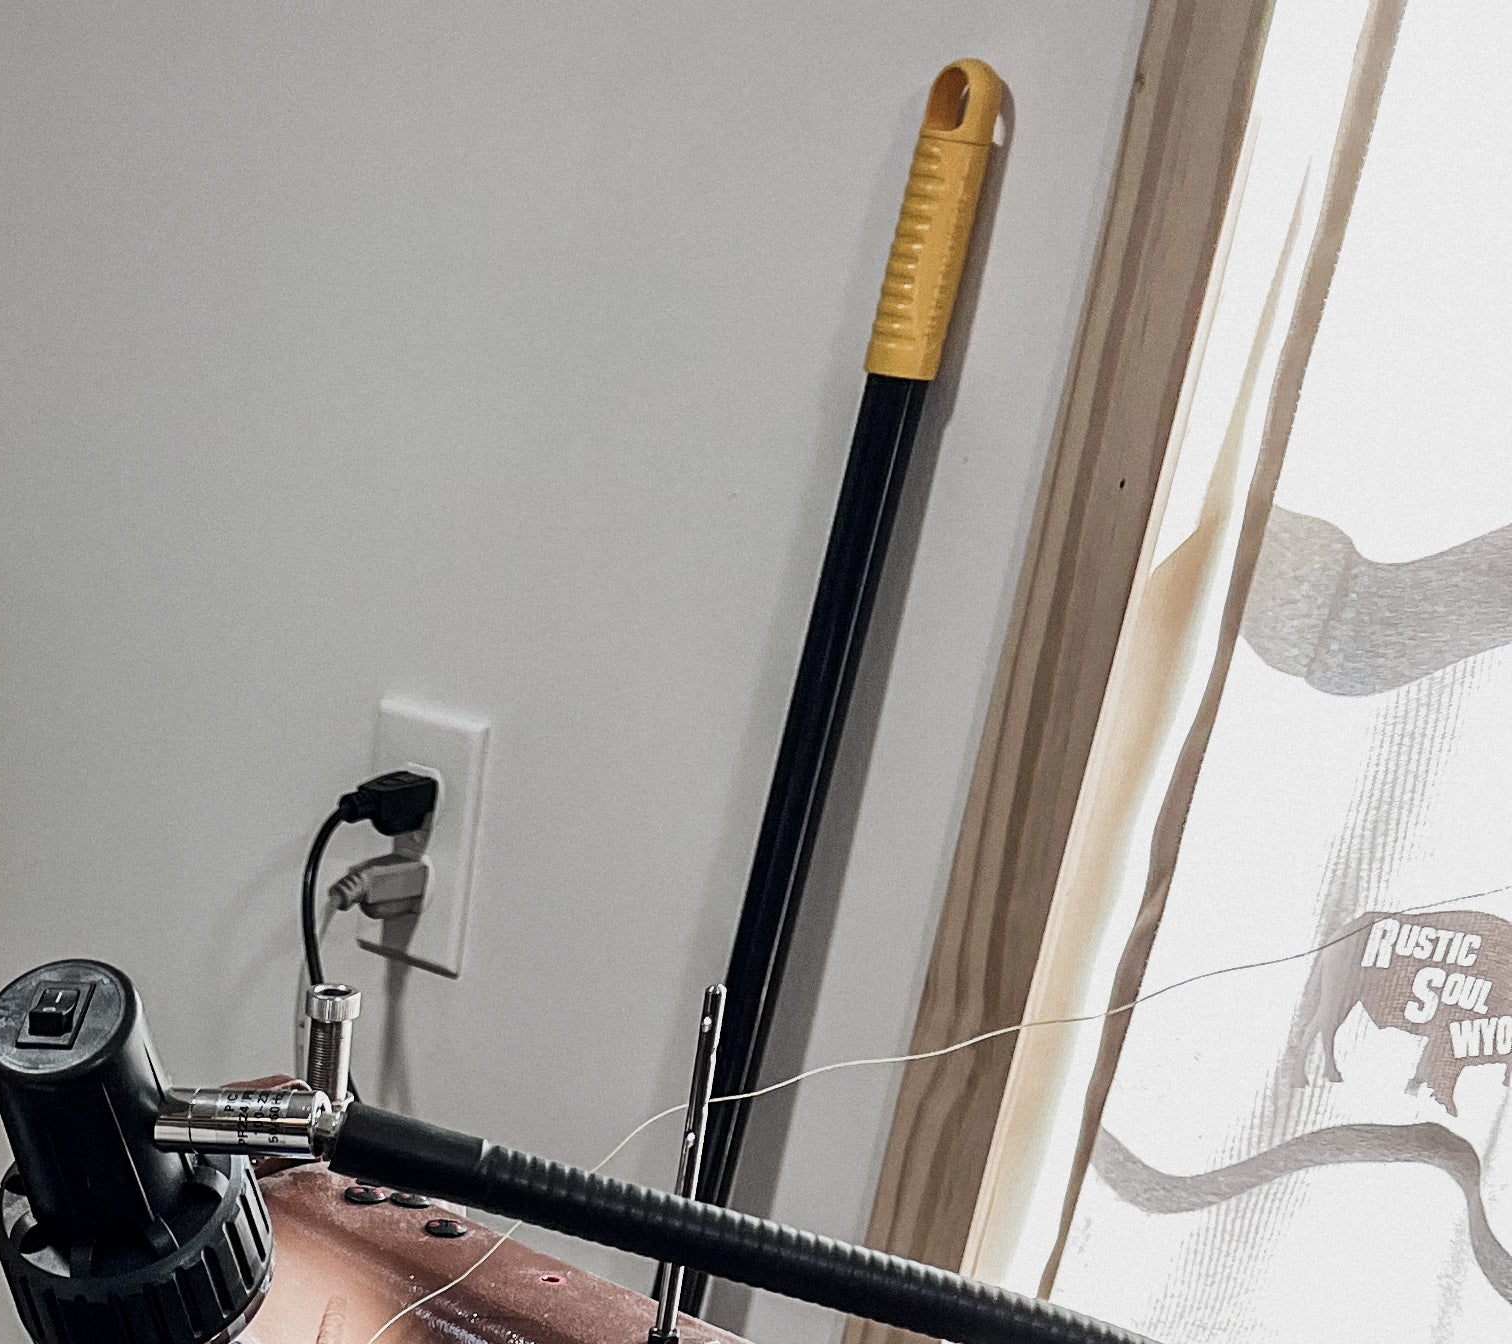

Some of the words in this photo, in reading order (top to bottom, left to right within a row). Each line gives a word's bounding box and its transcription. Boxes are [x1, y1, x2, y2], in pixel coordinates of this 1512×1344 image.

[1361, 918, 1482, 968] RUSTIC
[1404, 967, 1493, 1024] SOUL
[1450, 1016, 1512, 1059] WYO
